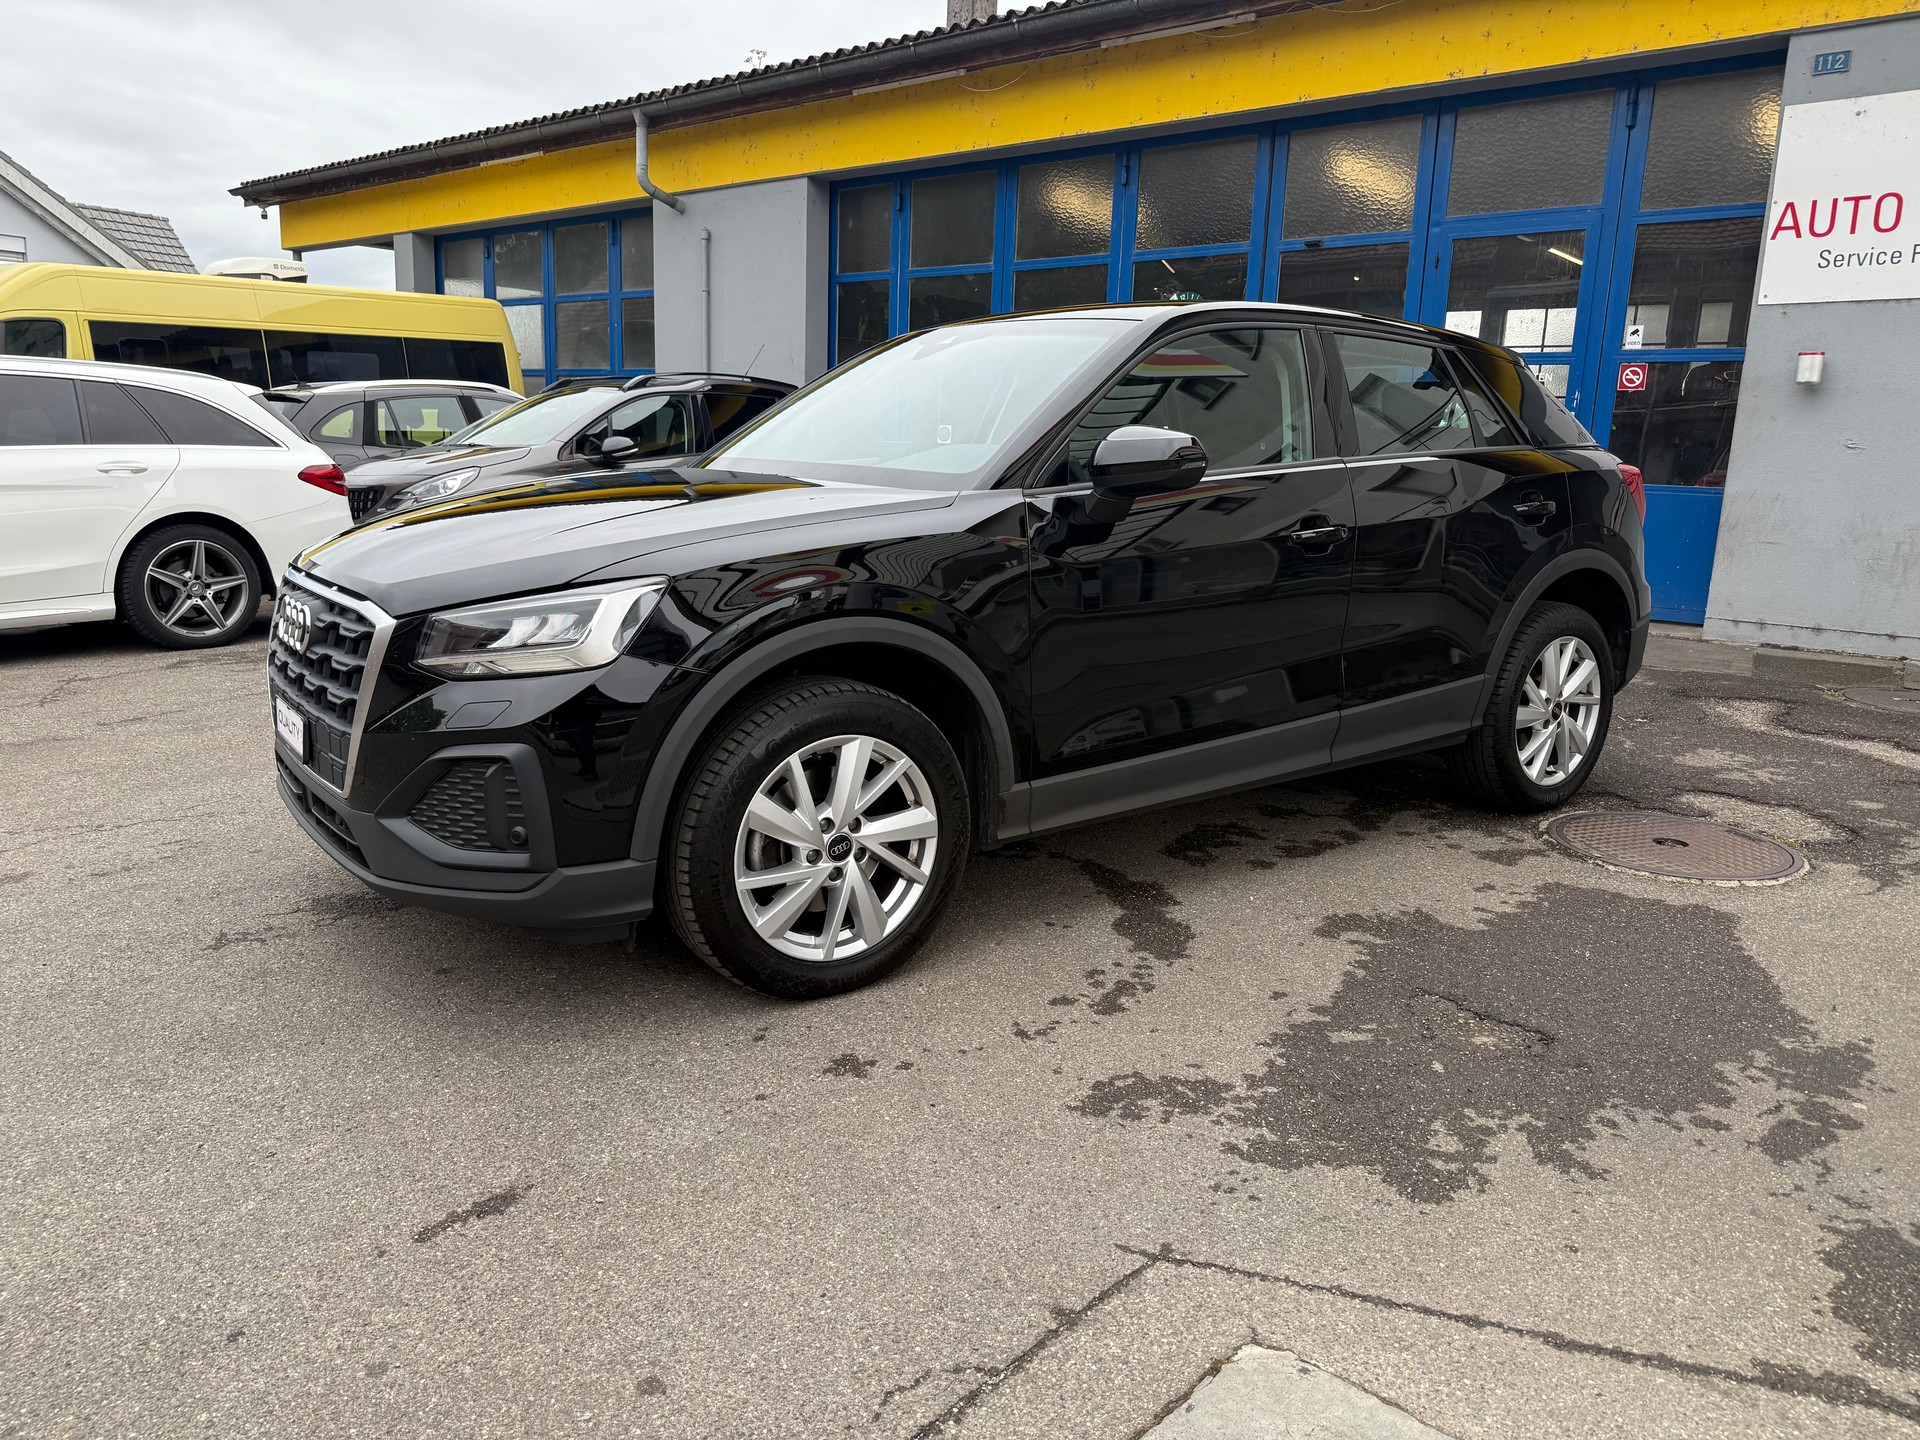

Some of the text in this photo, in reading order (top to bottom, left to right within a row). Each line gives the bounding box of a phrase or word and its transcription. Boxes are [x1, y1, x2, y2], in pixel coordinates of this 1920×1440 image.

[1816, 54, 1846, 72] 112
[1770, 192, 1904, 240] AUTO
[280, 264, 305, 272] Dometic
[1817, 246, 1903, 269] Service
[278, 709, 302, 741] QUALITY
